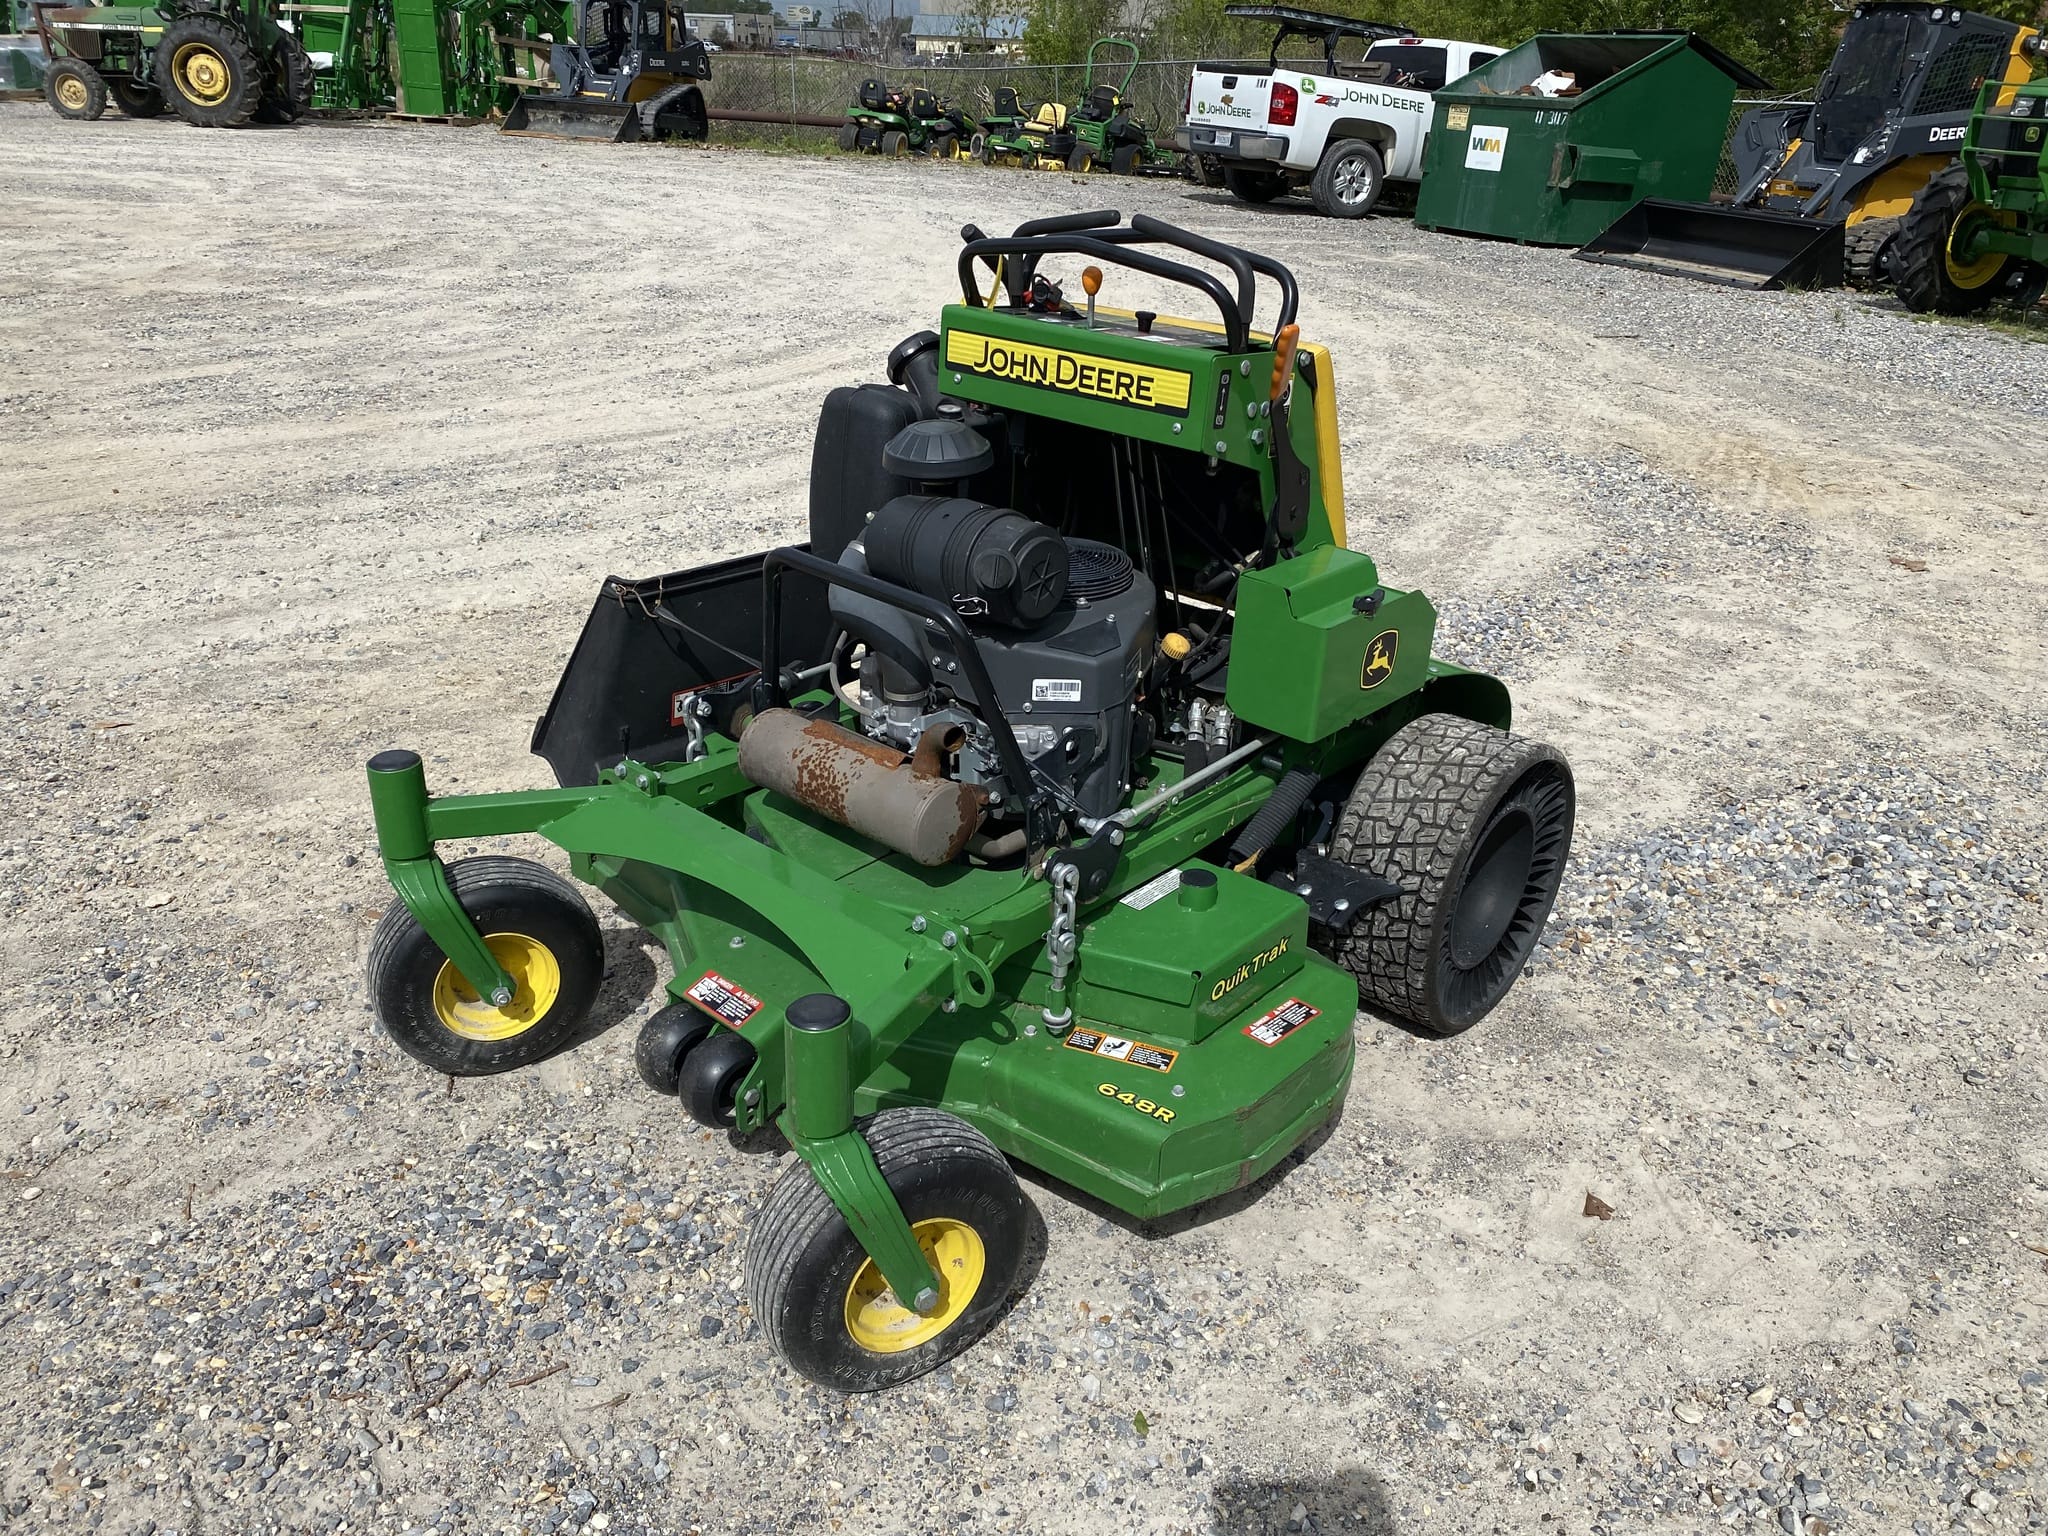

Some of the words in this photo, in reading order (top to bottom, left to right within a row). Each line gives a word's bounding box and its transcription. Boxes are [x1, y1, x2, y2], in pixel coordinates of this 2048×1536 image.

[1206, 102, 1226, 116] JOHN
[1226, 104, 1252, 118] DEERE
[1341, 87, 1379, 106] JOHN
[1382, 93, 1425, 114] DEERE
[1472, 137, 1500, 153] WM
[1929, 127, 1969, 142] DEER
[973, 340, 1049, 381] JOHN
[1055, 354, 1155, 403] DEERE
[1098, 1083, 1176, 1123] 648R
